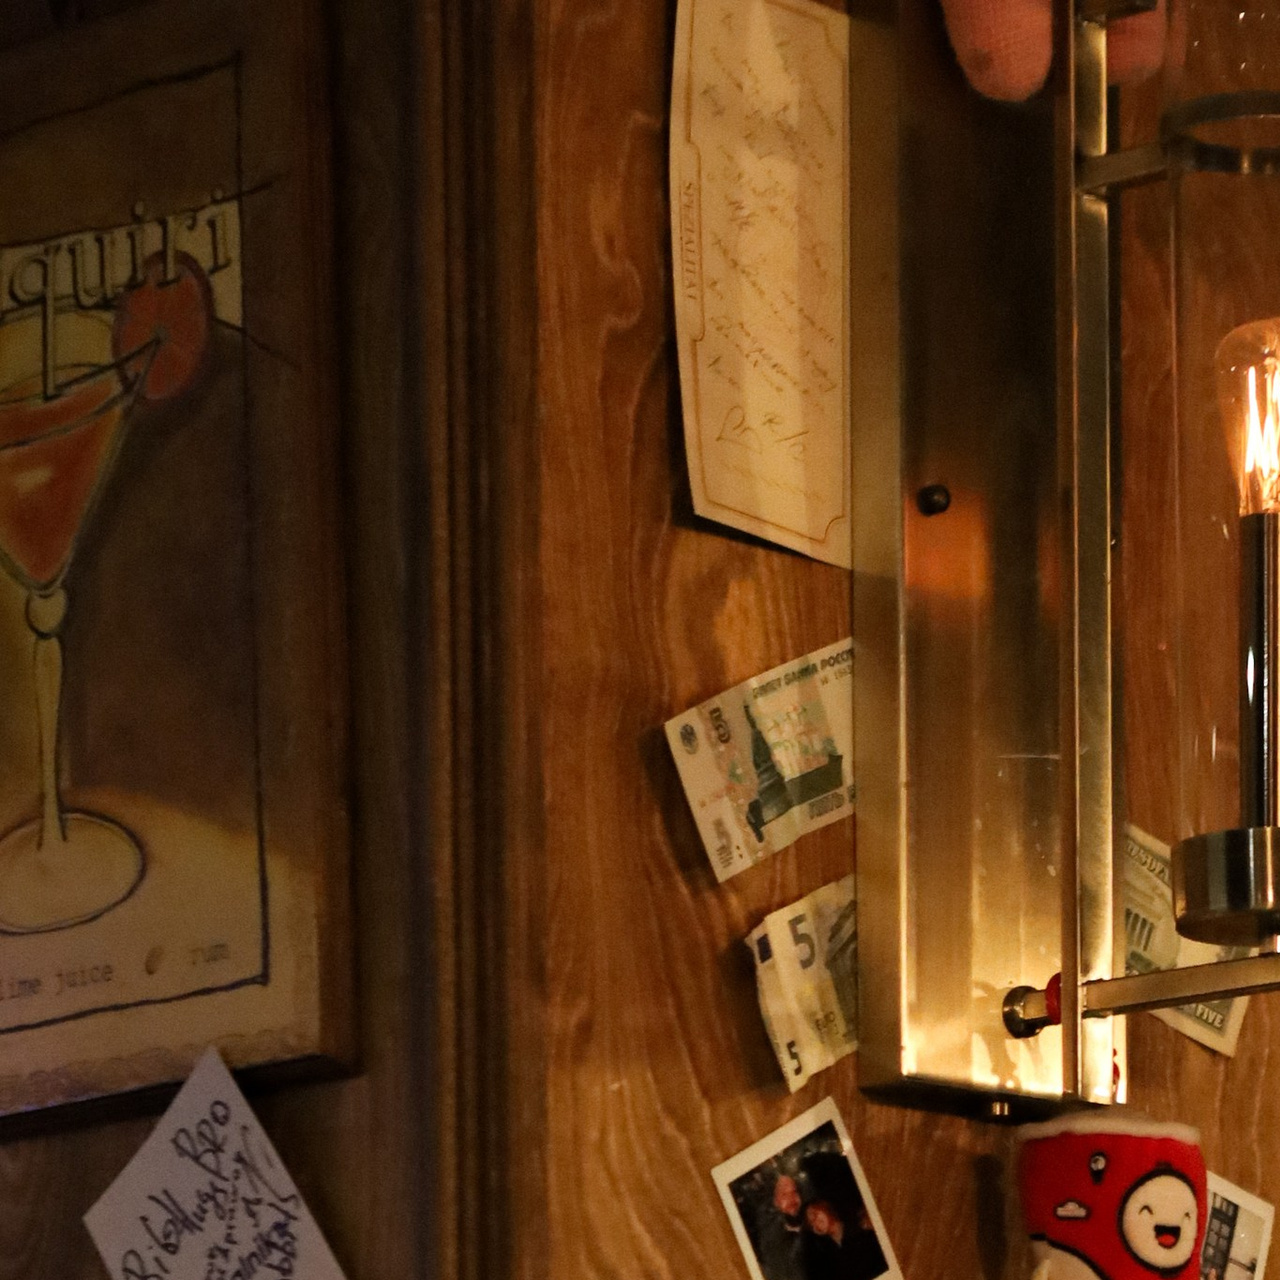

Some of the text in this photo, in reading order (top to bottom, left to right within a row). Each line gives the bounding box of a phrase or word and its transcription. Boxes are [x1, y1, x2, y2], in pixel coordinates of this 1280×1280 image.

[787, 912, 815, 970] 5
[1195, 1002, 1224, 1029] FIVE
[785, 1039, 803, 1077] 5
